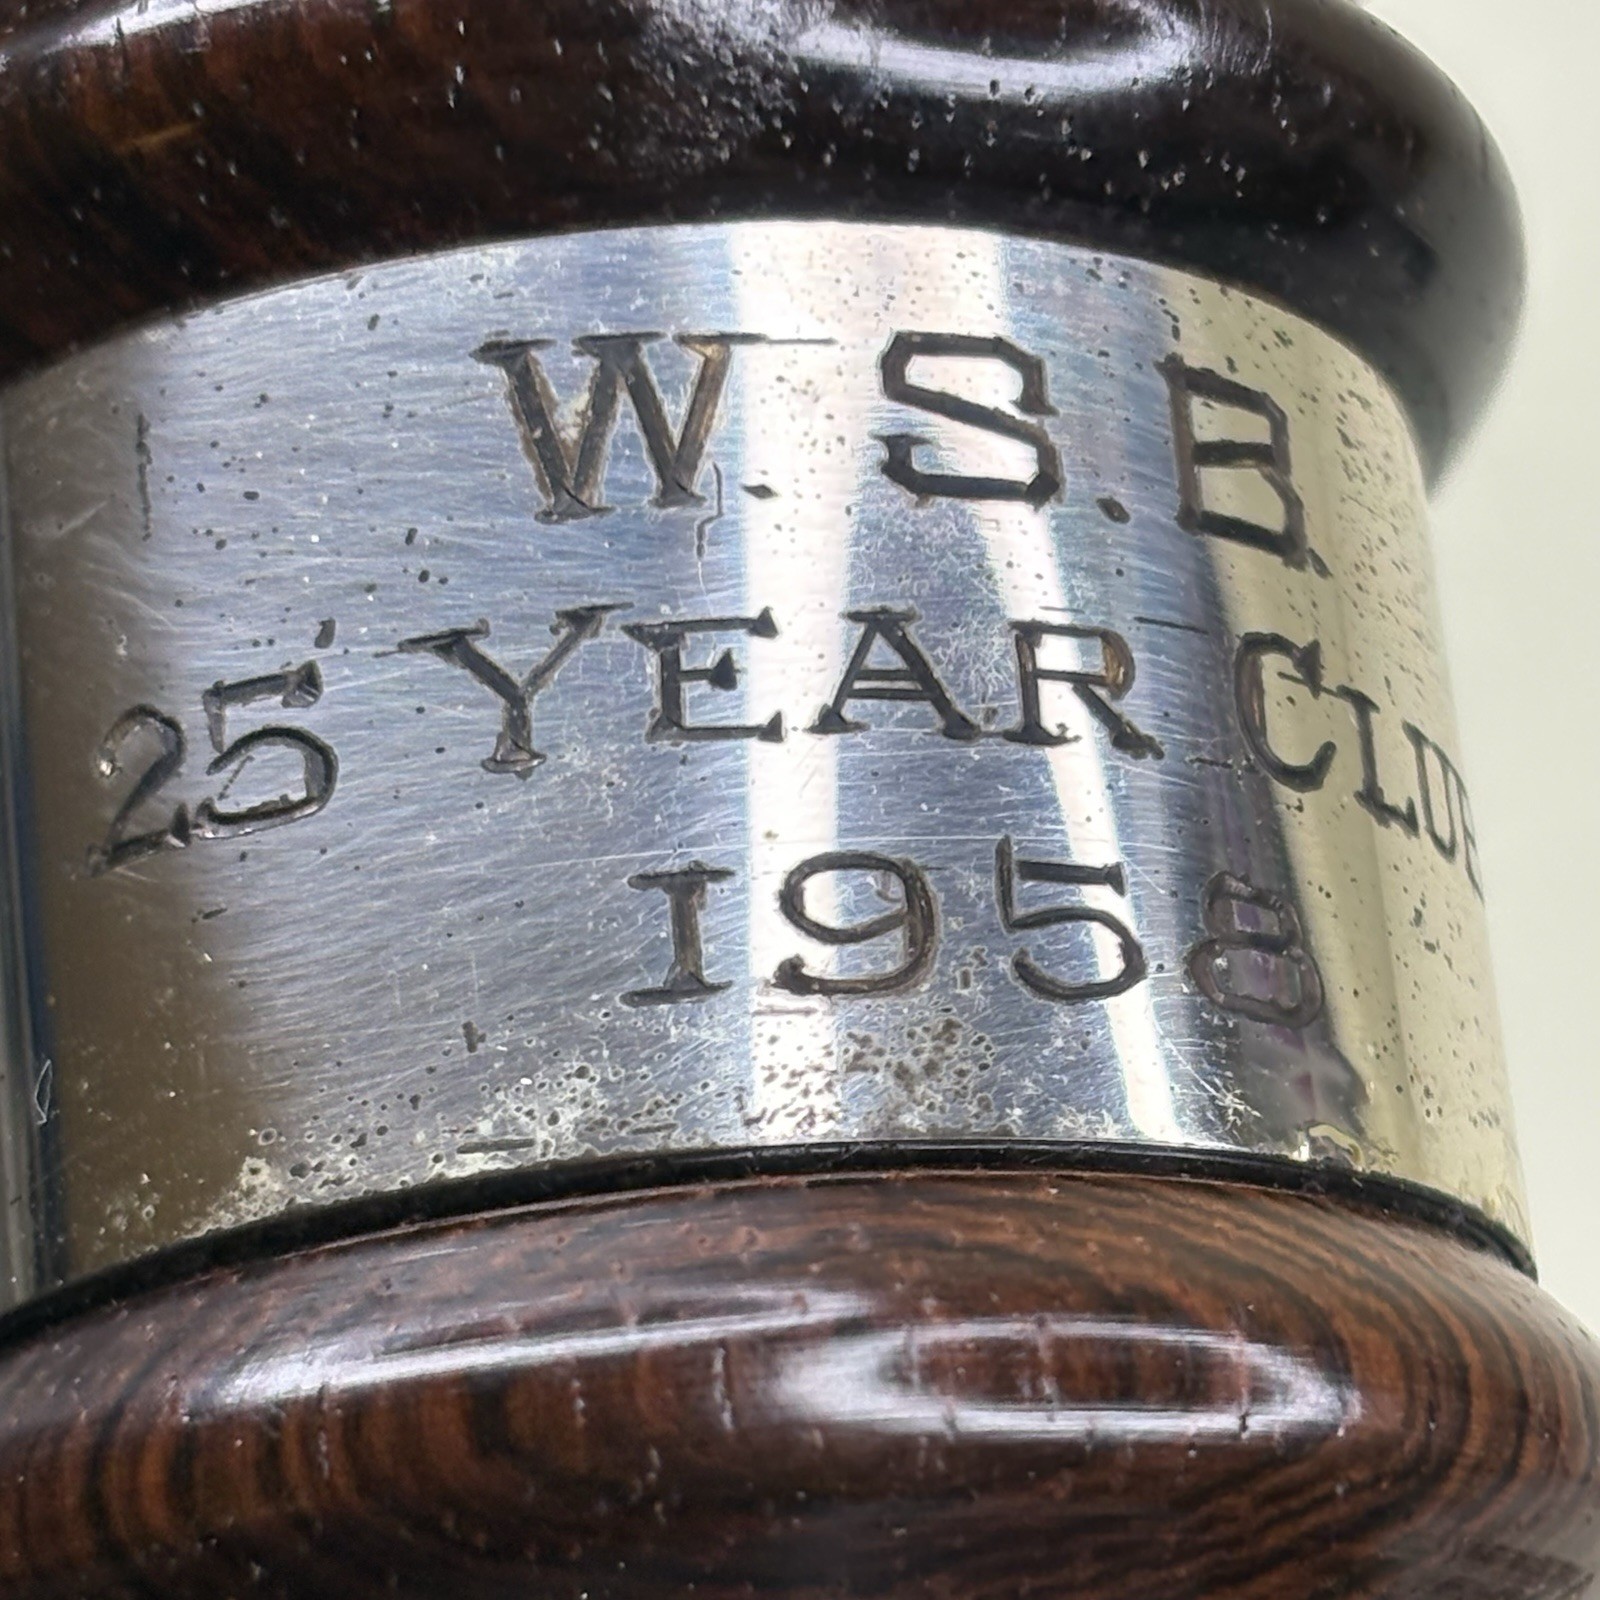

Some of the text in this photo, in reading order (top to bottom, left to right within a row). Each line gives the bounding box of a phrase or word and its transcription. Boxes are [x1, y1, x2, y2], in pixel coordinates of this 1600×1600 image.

[88, 660, 338, 876] 25
[398, 602, 1165, 780] YEAR
[620, 835, 1327, 1031] 1958
